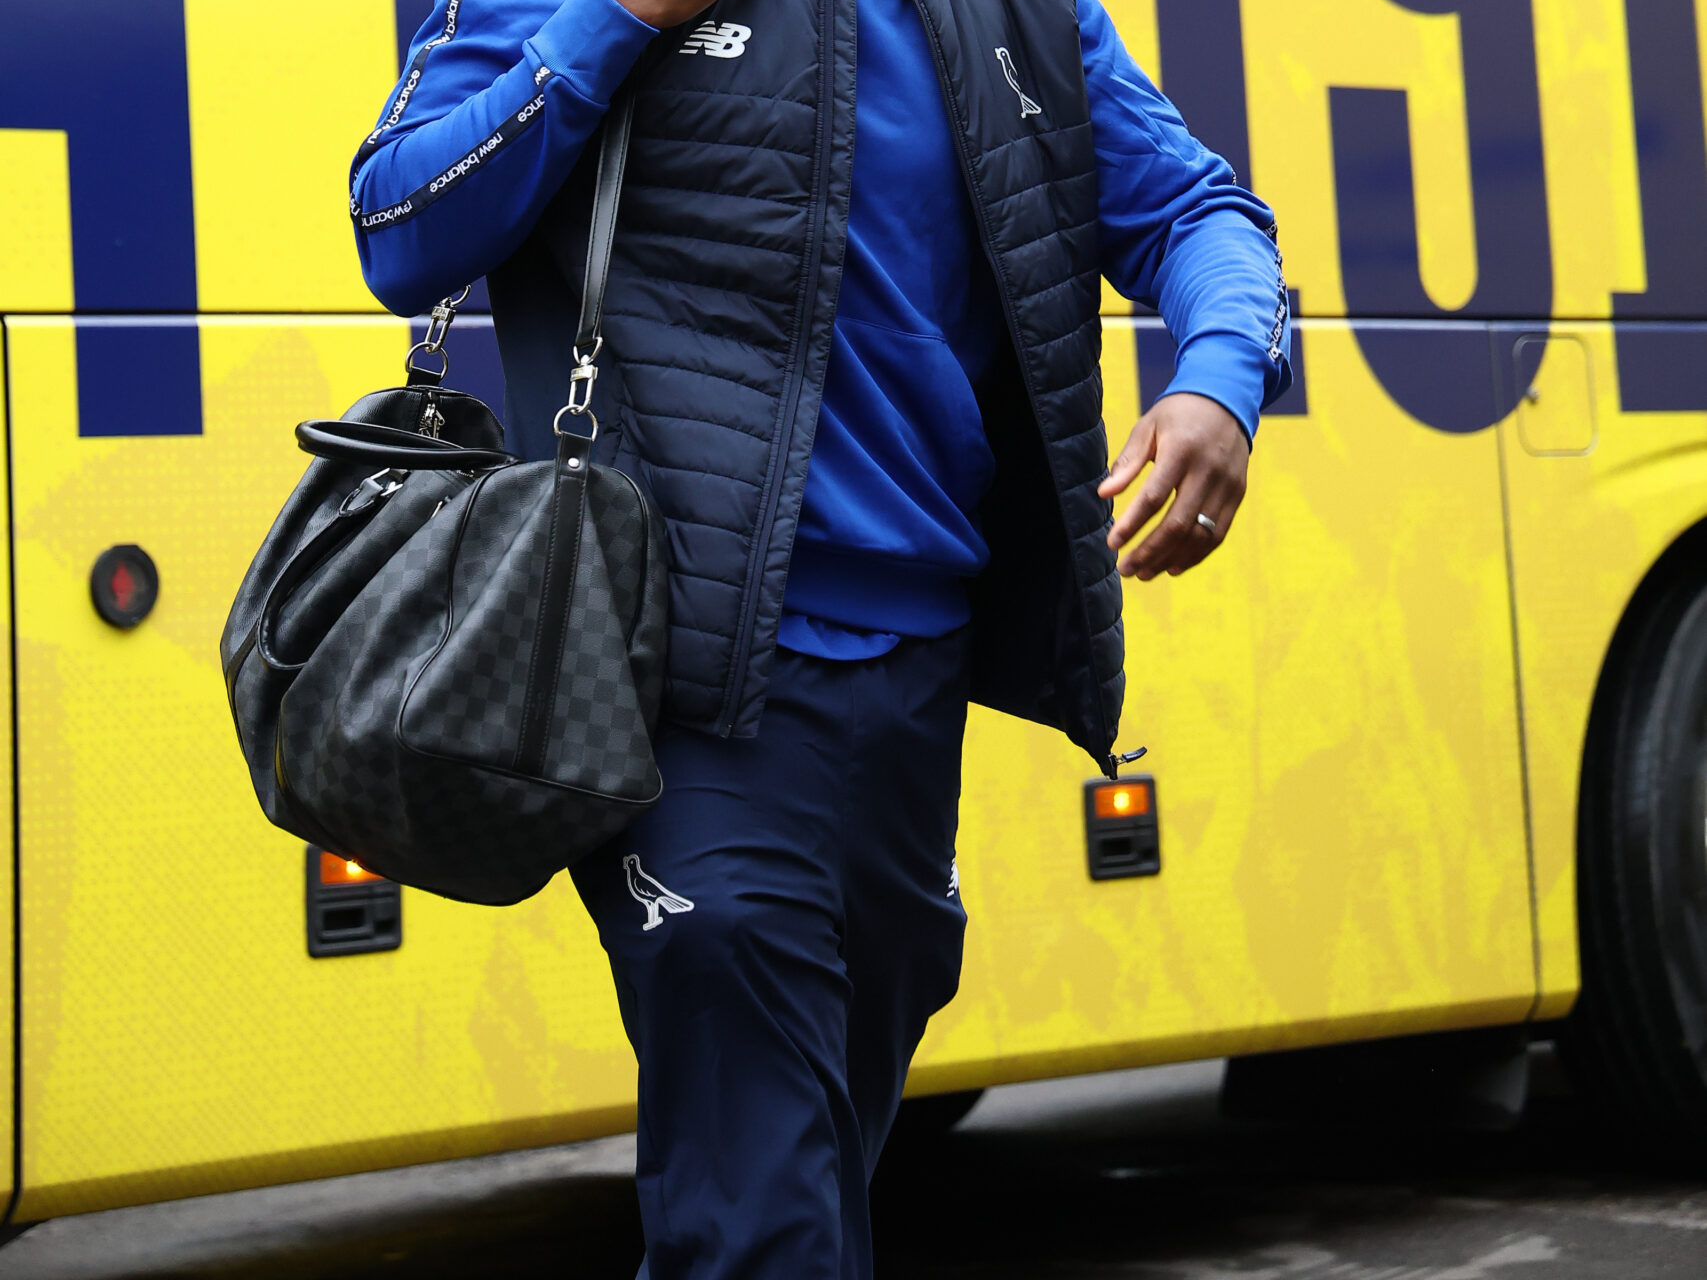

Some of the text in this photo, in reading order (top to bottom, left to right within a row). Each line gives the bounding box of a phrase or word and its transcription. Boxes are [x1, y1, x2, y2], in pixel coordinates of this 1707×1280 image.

[678, 19, 752, 59] NB
[387, 69, 421, 125] balance
[517, 93, 546, 123] ance
[429, 131, 504, 193] new balance
